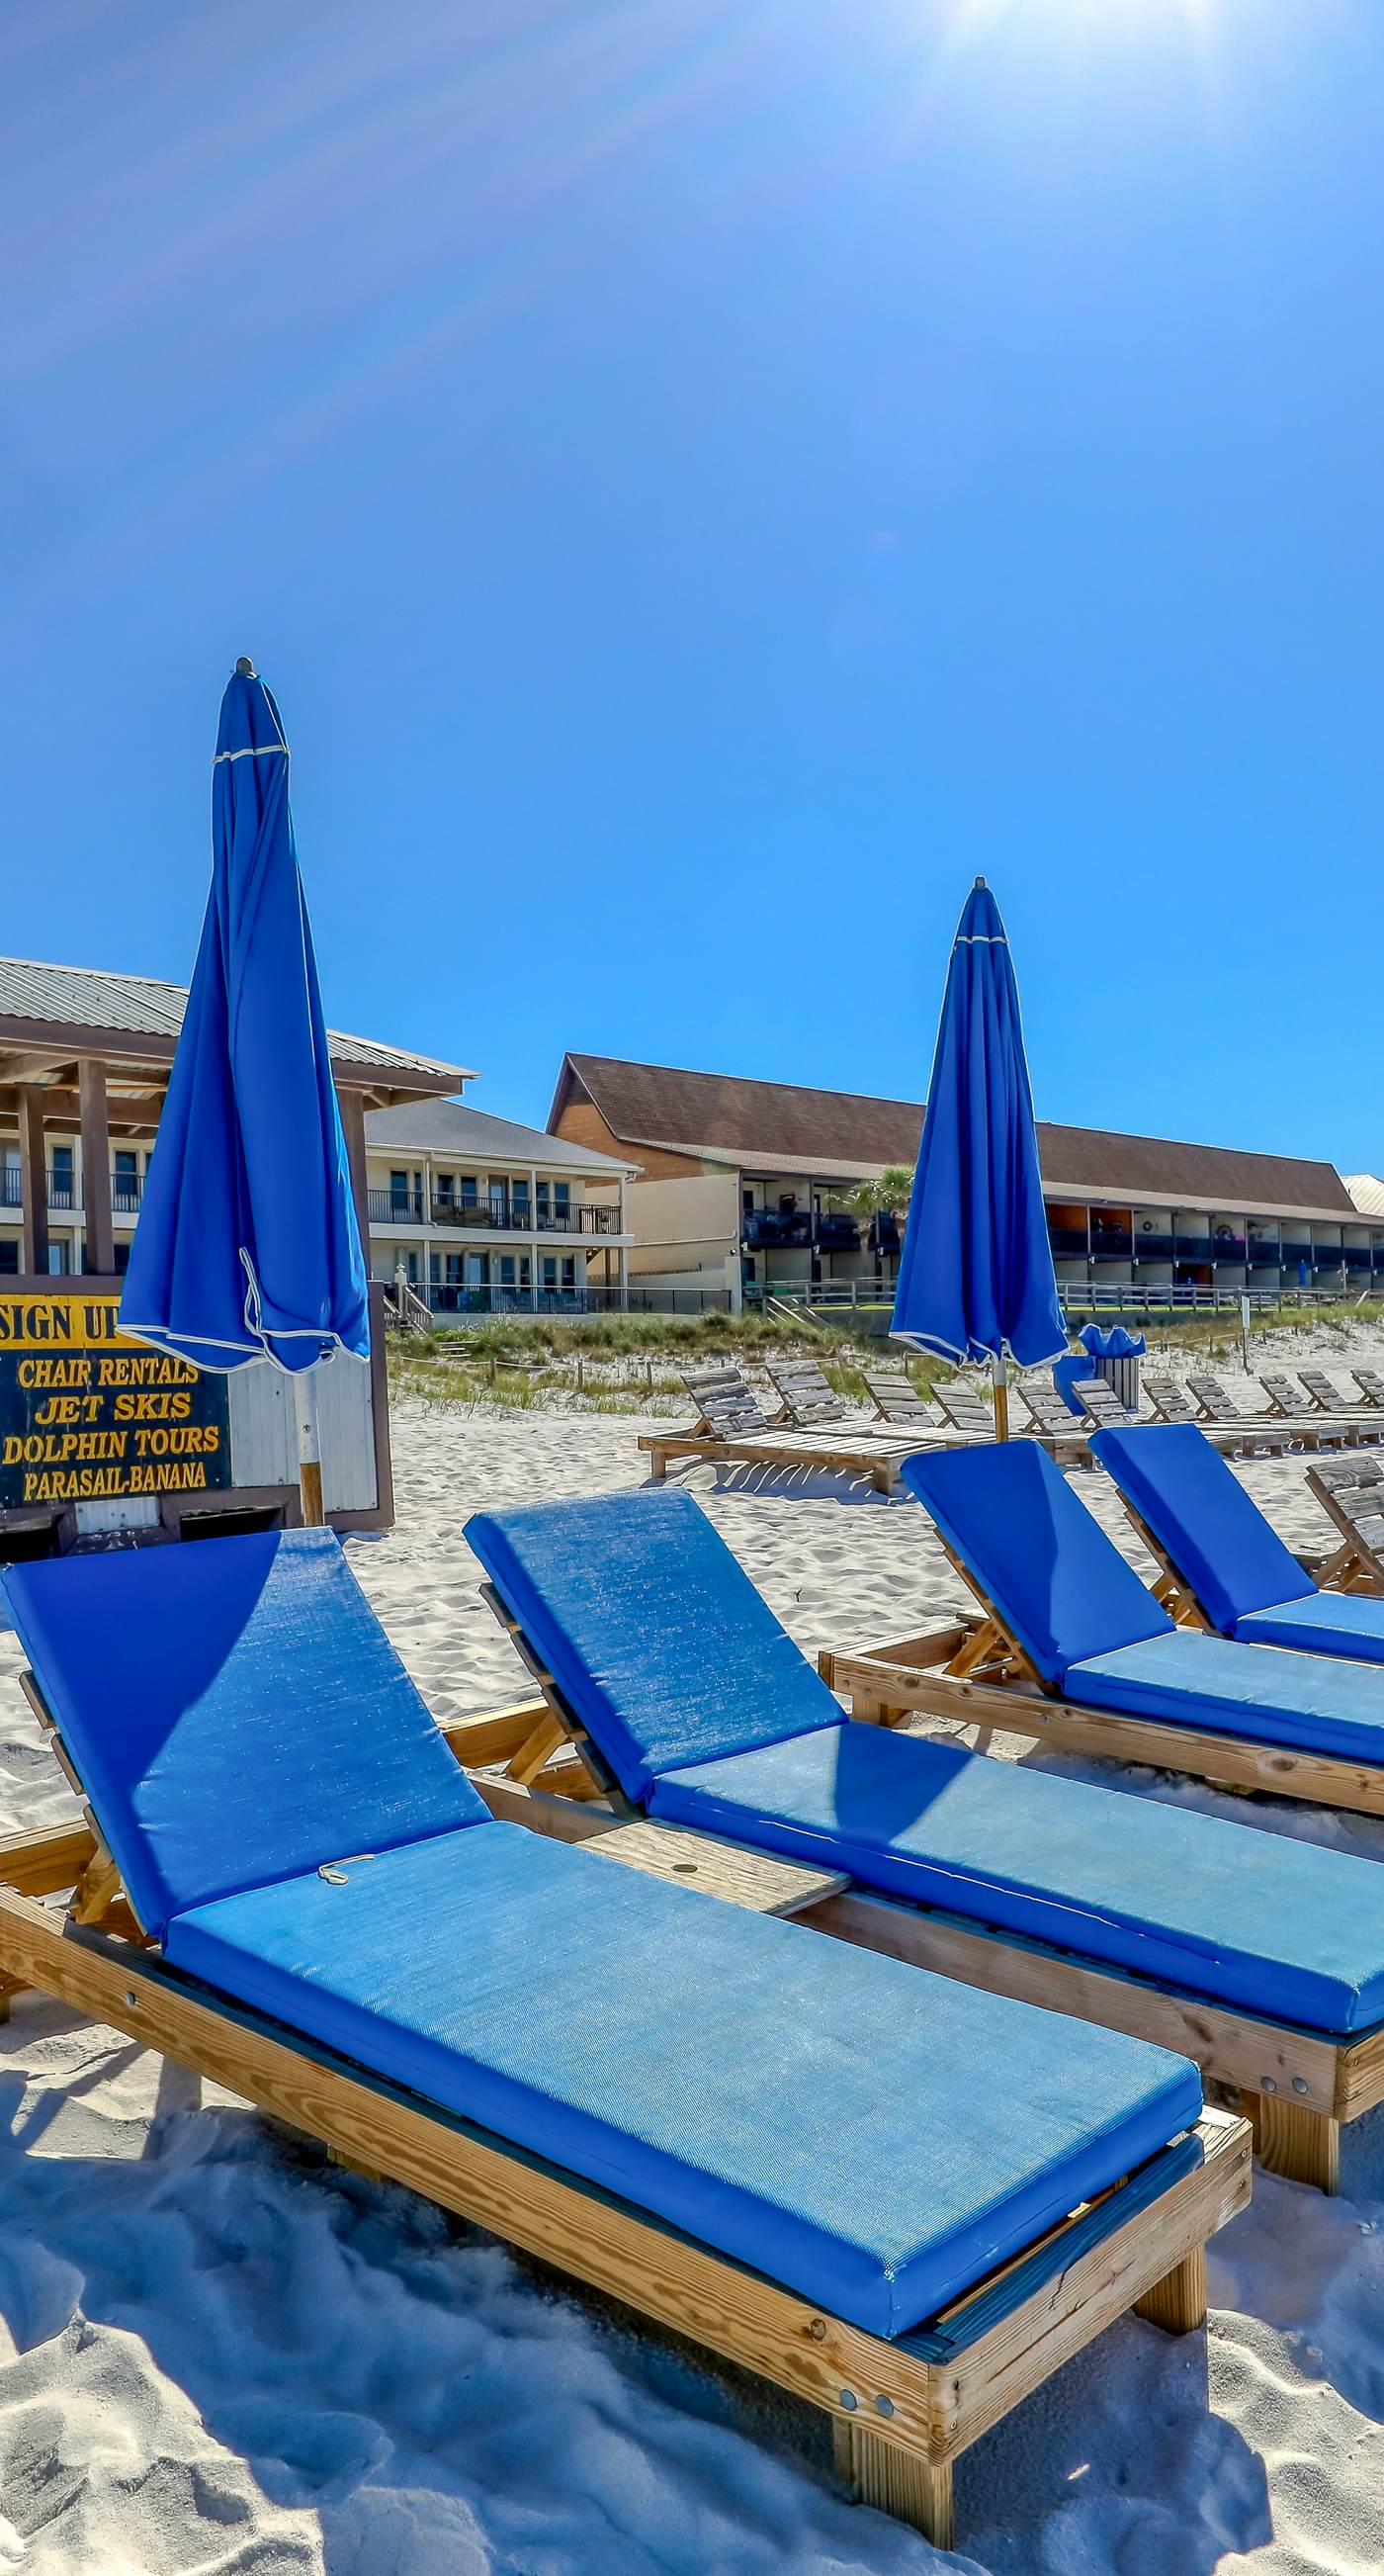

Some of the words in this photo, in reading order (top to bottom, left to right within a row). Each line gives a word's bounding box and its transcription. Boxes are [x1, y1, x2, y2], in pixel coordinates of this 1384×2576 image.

[0, 1304, 71, 1340] SIGN
[18, 1359, 92, 1388] CHAIR
[98, 1358, 199, 1385] RENTALS
[35, 1395, 103, 1425] JET
[114, 1392, 191, 1421] SKIS
[2, 1431, 128, 1465] DOLPHIN
[134, 1426, 219, 1456] TOURS
[24, 1462, 207, 1501] PARASAIL-BANANA
